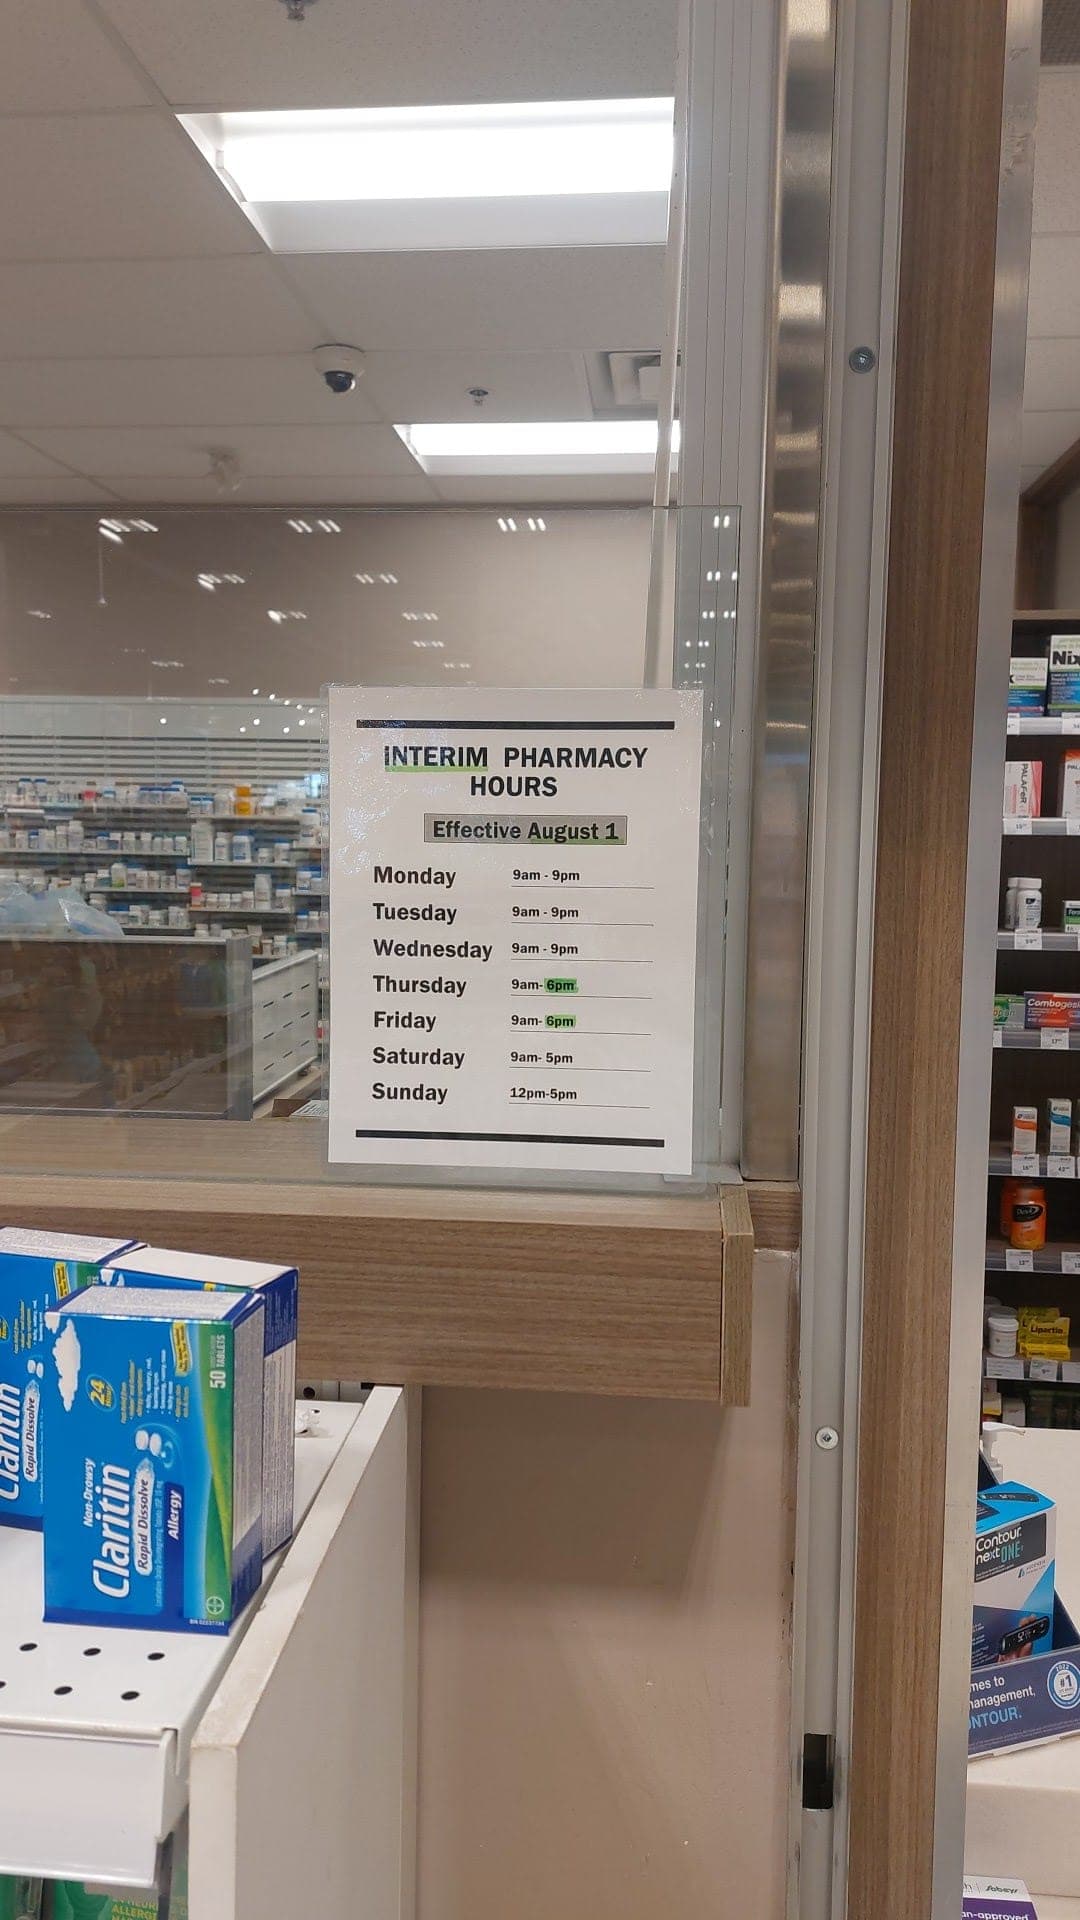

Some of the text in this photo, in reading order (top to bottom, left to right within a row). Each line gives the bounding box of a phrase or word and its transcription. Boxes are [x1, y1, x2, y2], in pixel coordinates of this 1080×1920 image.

[384, 745, 649, 769] INTERIM PHARMACY
[470, 776, 558, 798] HOURS
[432, 820, 619, 843] Effective August 1
[373, 866, 457, 889] Monday
[512, 869, 541, 882] 9am
[552, 870, 580, 884] 9pm
[373, 902, 457, 925] Tuesday
[511, 906, 540, 919] 9am
[551, 906, 579, 920] 9pm
[373, 939, 493, 962] Wednesday
[511, 943, 539, 955] 9am
[550, 943, 578, 957] 9pm
[373, 975, 467, 997] Thursday
[546, 979, 575, 993] 6pm
[373, 1011, 437, 1033] Friday
[546, 1015, 574, 1028] 6pm
[372, 1047, 465, 1069] Saturday
[545, 1052, 573, 1065] 5pm
[372, 1083, 448, 1104] Sunday
[215, 1335, 226, 1367] TABLETS
[210, 1369, 226, 1389] 50
[90, 1379, 105, 1406] 24
[25, 1397, 37, 1477] Rapid Dissolve
[83, 1458, 97, 1527] Non-Drowsy
[138, 1479, 150, 1570] Rapid Dissolve
[167, 1490, 182, 1540] Allergy
[93, 1463, 130, 1598] Claritin
[976, 1526, 1021, 1552] Contour
[993, 1676, 1005, 1687] to
[969, 1707, 1022, 1728] NTOUR.
